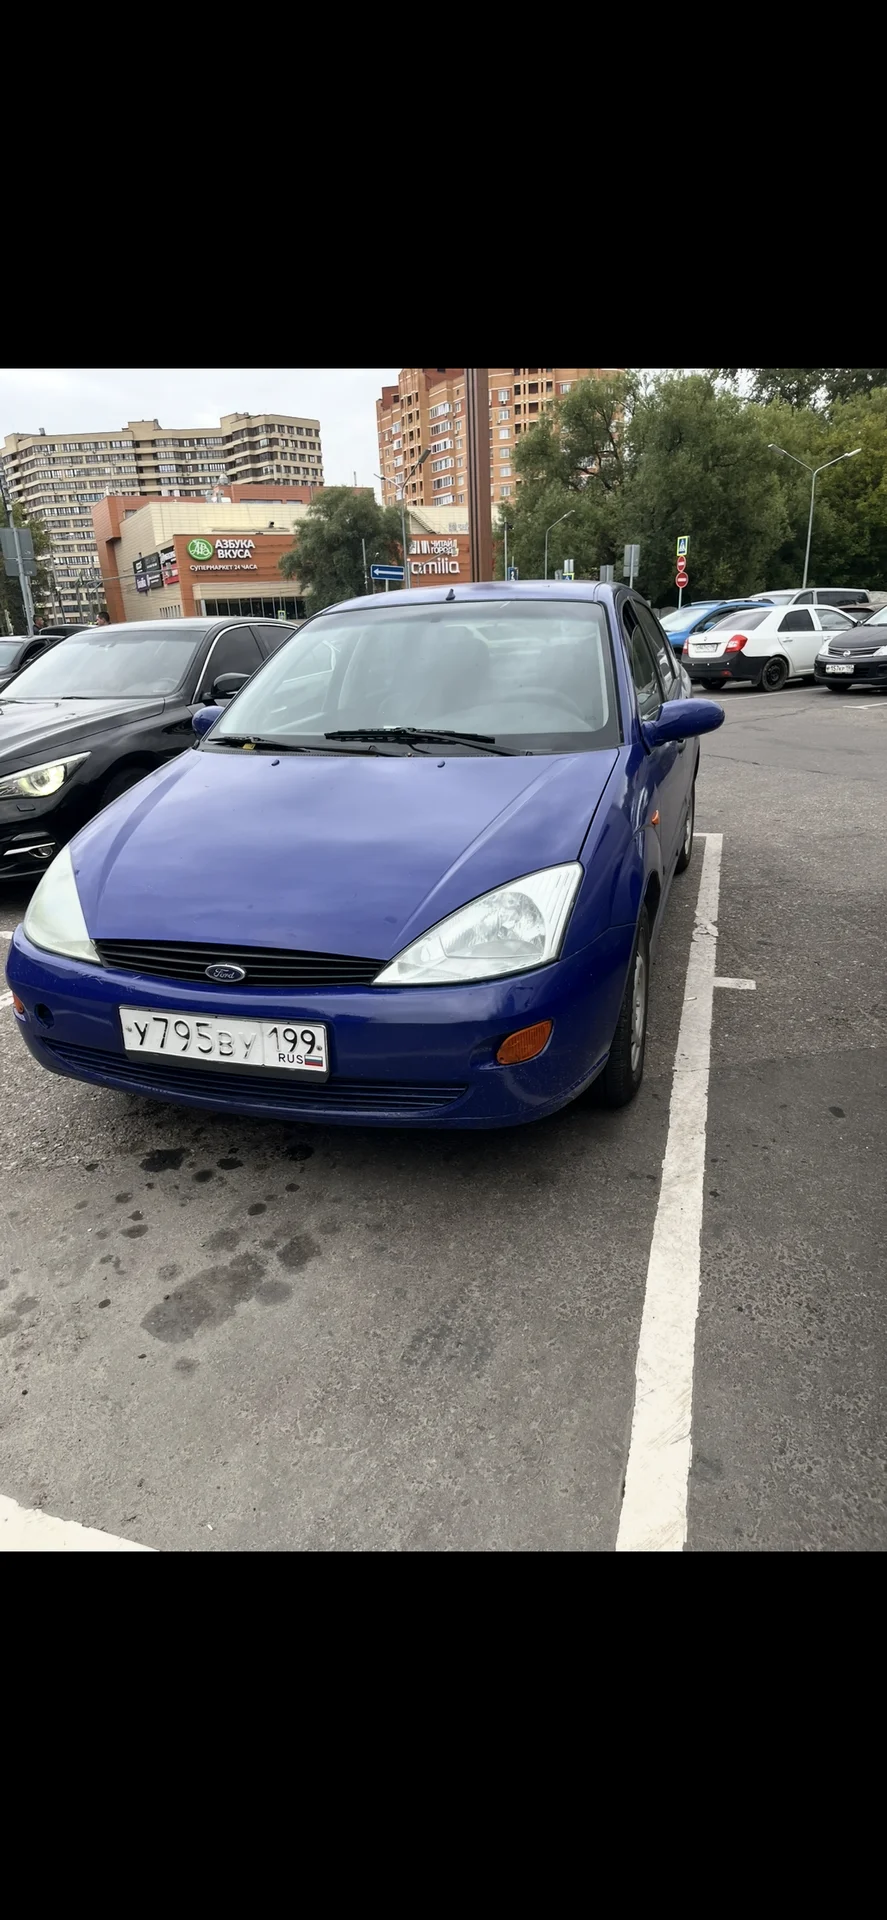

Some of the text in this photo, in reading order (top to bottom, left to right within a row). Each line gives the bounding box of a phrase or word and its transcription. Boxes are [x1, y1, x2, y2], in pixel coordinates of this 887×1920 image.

[215, 539, 256, 549] АЗБУКА
[431, 538, 453, 547] ЧИТАЙ
[217, 549, 252, 559] ВКУСА
[189, 564, 233, 572] СУПЕРМАРКЕТ
[407, 557, 460, 574] amilia
[213, 968, 235, 979] Ford
[266, 1026, 317, 1055] 199
[278, 1052, 304, 1065] RUS
